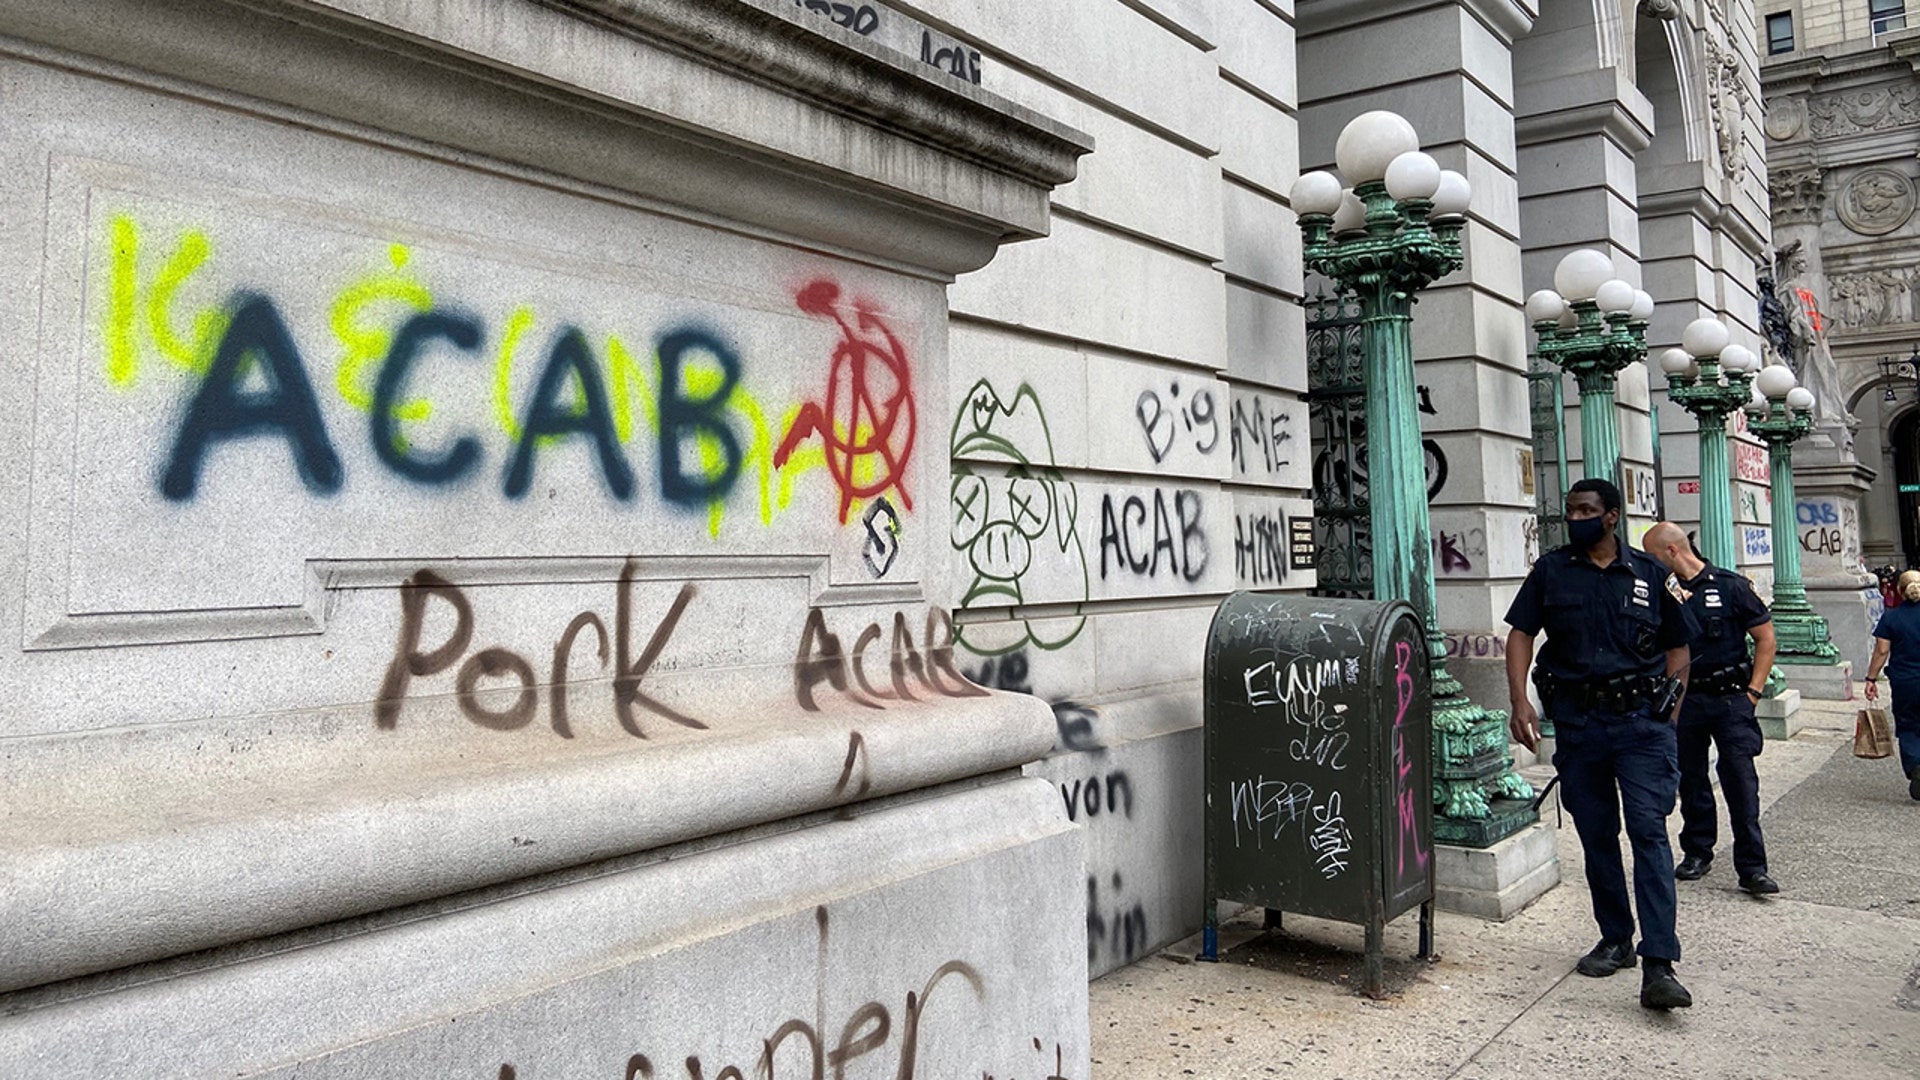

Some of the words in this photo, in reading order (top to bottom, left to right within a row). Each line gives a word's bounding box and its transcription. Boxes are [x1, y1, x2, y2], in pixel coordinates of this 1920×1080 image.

[157, 288, 743, 509] ACAB
[1100, 488, 1209, 583] ACAB
[1061, 769, 1132, 822] von
